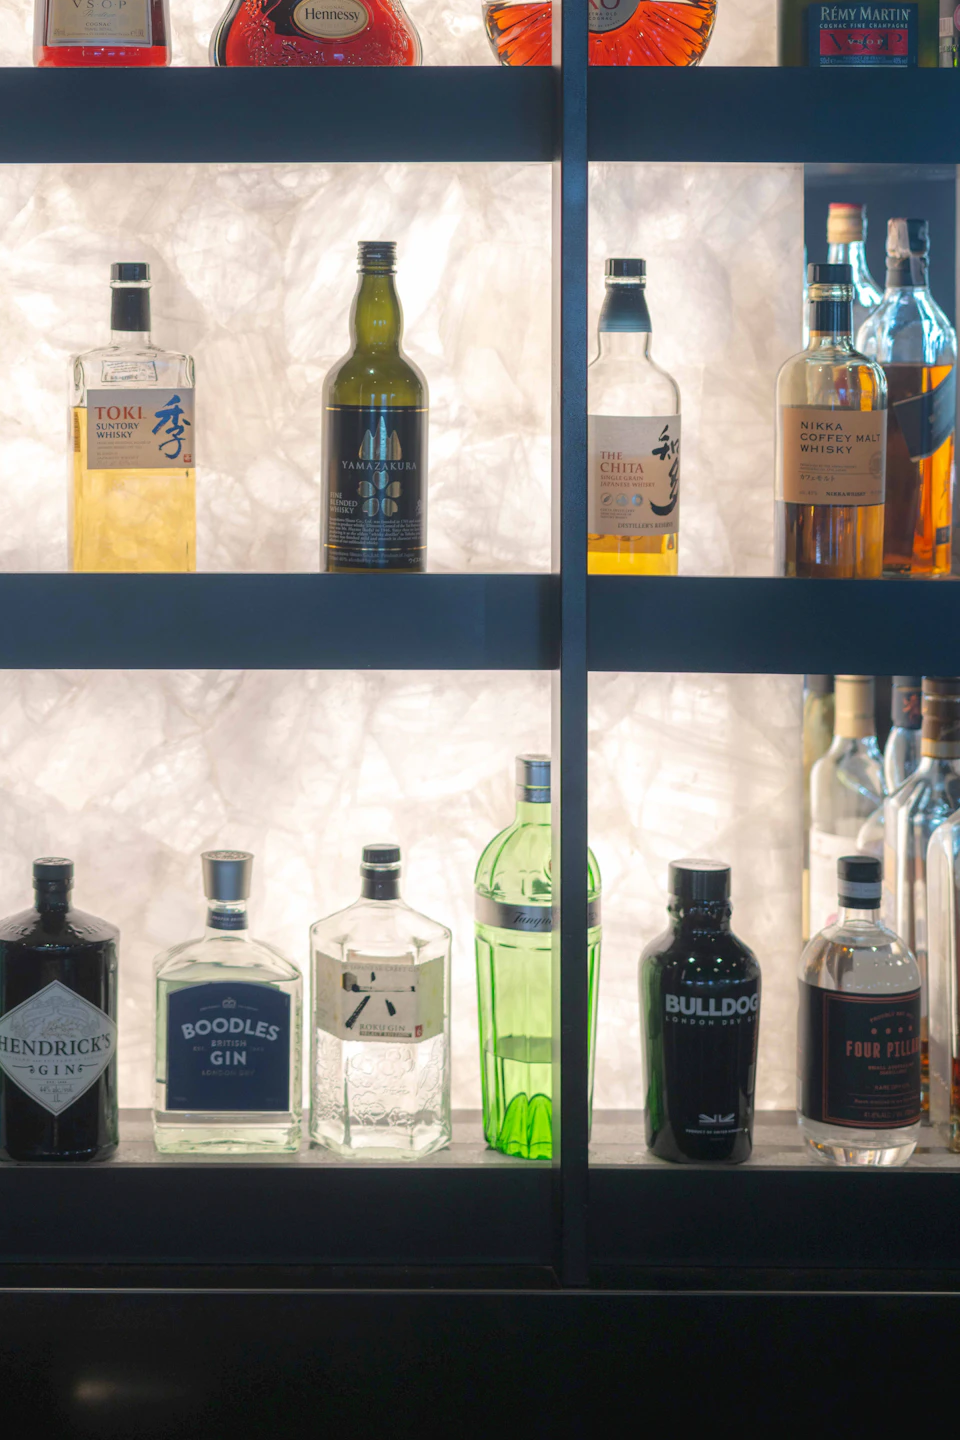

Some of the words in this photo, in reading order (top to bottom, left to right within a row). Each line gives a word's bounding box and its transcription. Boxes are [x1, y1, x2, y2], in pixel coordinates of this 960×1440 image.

[304, 8, 361, 23] Hennessy
[821, 6, 856, 20] RÉMY
[860, 8, 908, 20] MARTIN
[94, 406, 144, 420] TOKI
[96, 422, 140, 430] SUNTORY
[801, 422, 843, 431] NIKKA
[800, 432, 852, 442] COFFEY
[856, 434, 881, 442] MALT
[800, 444, 852, 454] WHISKY
[600, 451, 623, 460] THE
[342, 460, 418, 470] YAMAZAKURA
[600, 462, 644, 474] CHITA
[330, 500, 358, 508] BLENDED
[665, 994, 758, 1016] BULLDOG
[665, 1017, 714, 1026] LONDON
[181, 1017, 280, 1042] BOODLES
[359, 1024, 384, 1032] ROKU
[388, 1024, 405, 1032] GIN
[846, 1040, 880, 1058] FOUR
[210, 1052, 246, 1065] GIN
[38, 1064, 75, 1076] GIN
